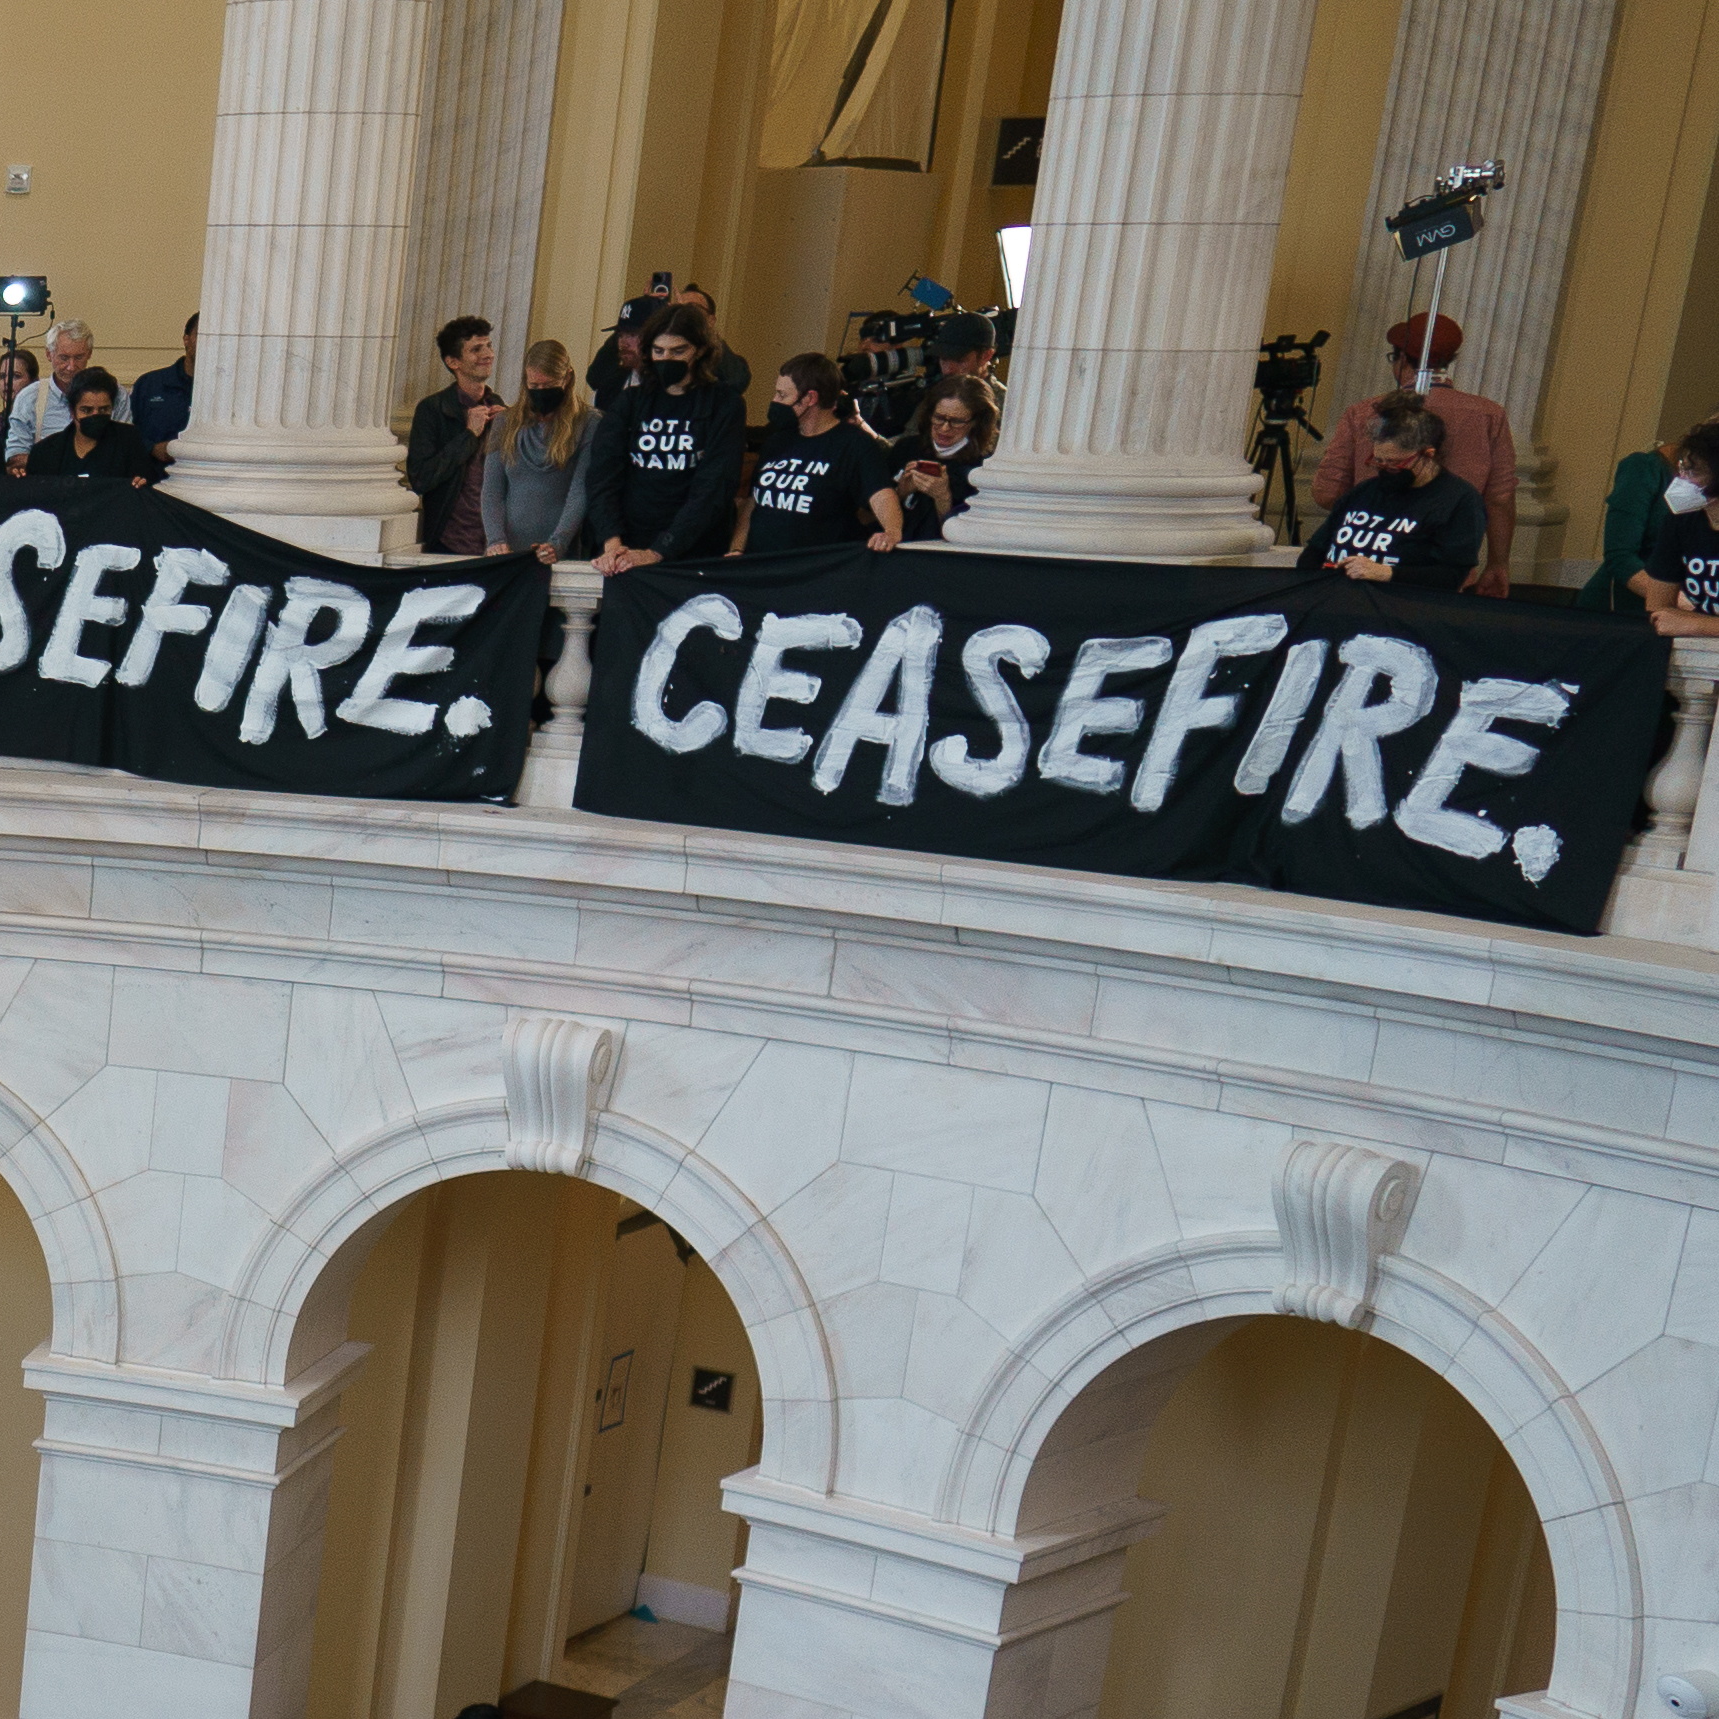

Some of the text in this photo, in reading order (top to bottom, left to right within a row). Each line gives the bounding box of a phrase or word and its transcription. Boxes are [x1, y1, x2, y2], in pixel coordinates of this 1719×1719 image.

[639, 435, 694, 452] OUR
[806, 461, 829, 475] IN
[759, 474, 809, 490] OUR
[1344, 511, 1417, 534] NOT IN
[1336, 526, 1393, 551] OUR
[631, 592, 1570, 883] CEASEFIRE.
